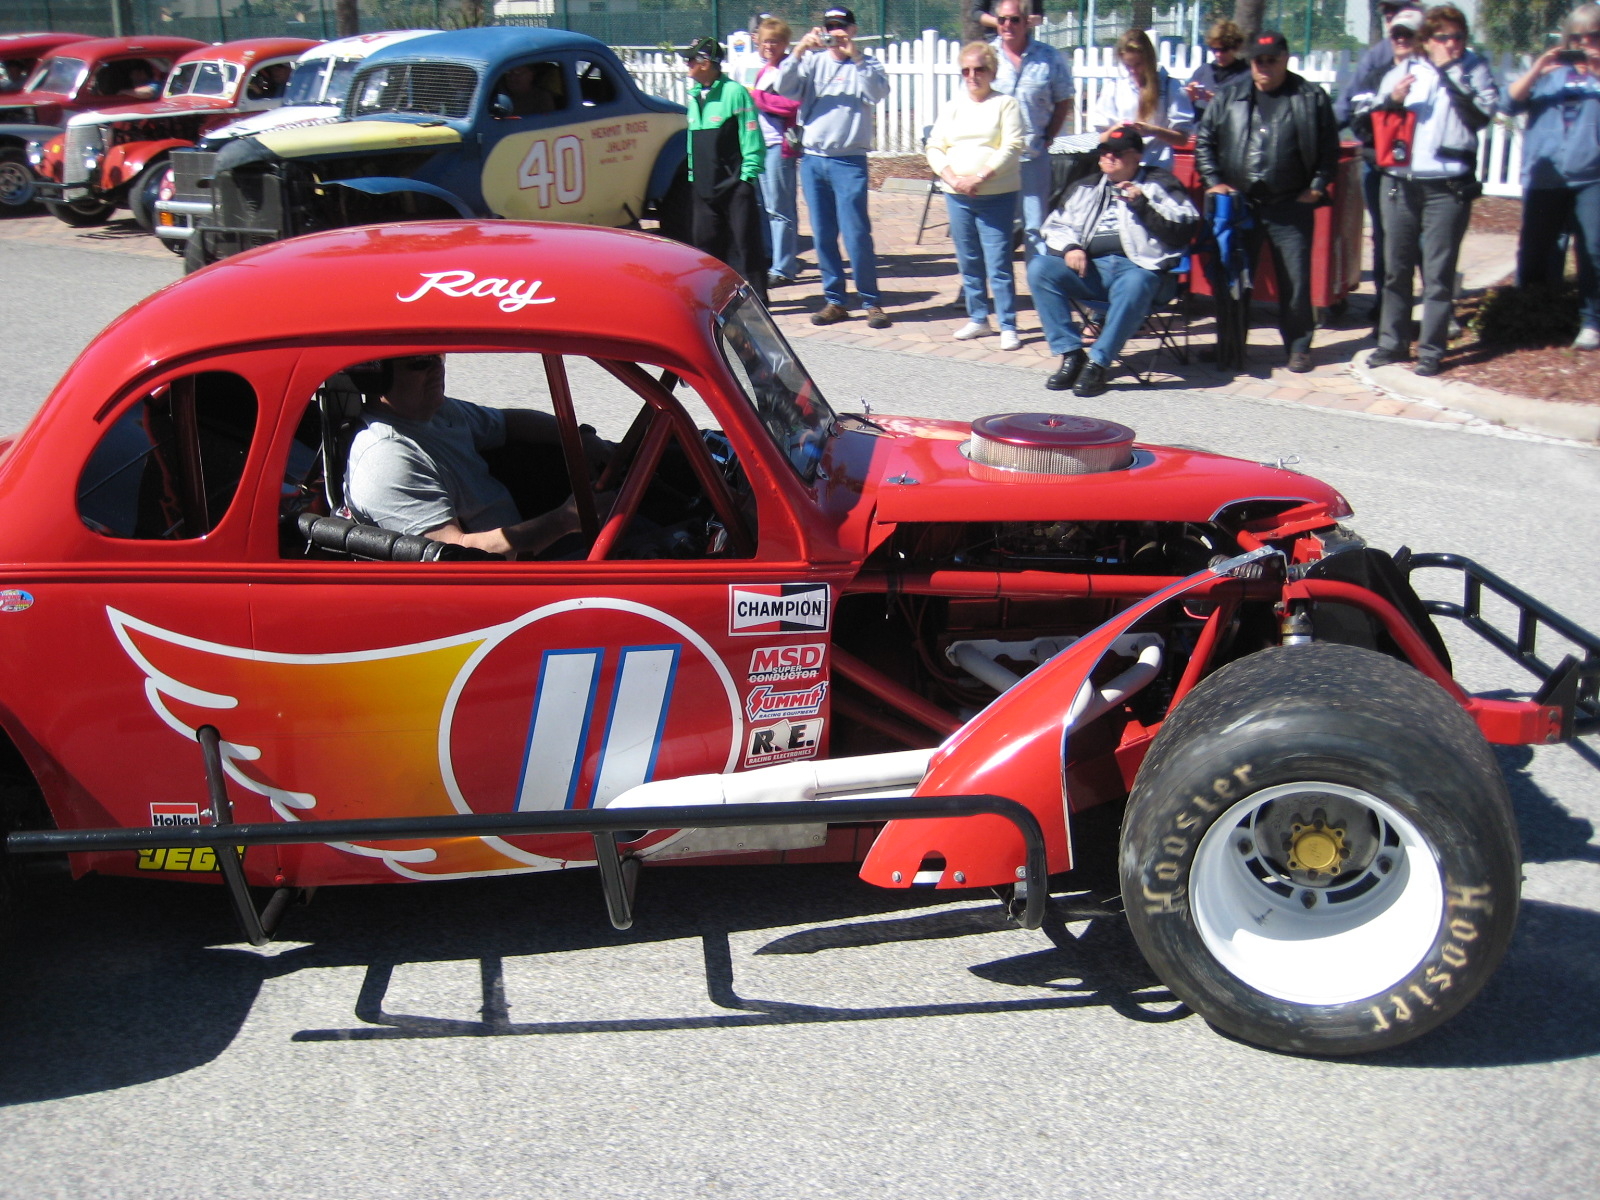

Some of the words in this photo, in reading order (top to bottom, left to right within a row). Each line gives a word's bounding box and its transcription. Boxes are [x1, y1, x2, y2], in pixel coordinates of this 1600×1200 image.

[518, 134, 586, 209] 40
[396, 270, 556, 313] Ray
[737, 600, 822, 617] CHAMPION
[752, 646, 821, 673] MSD
[772, 664, 803, 674] SUPER
[748, 669, 818, 683] CONDUCTOR
[759, 711, 781, 719] RACING
[782, 708, 817, 717] EQUIPMENT
[512, 643, 683, 813] 11
[748, 755, 772, 765] RACING
[773, 748, 812, 761] ELECTRONICS
[153, 814, 198, 827] Holley
[1143, 763, 1253, 921] Hoosier
[138, 845, 245, 872] JEG
[1371, 874, 1493, 1033] Hoosier
